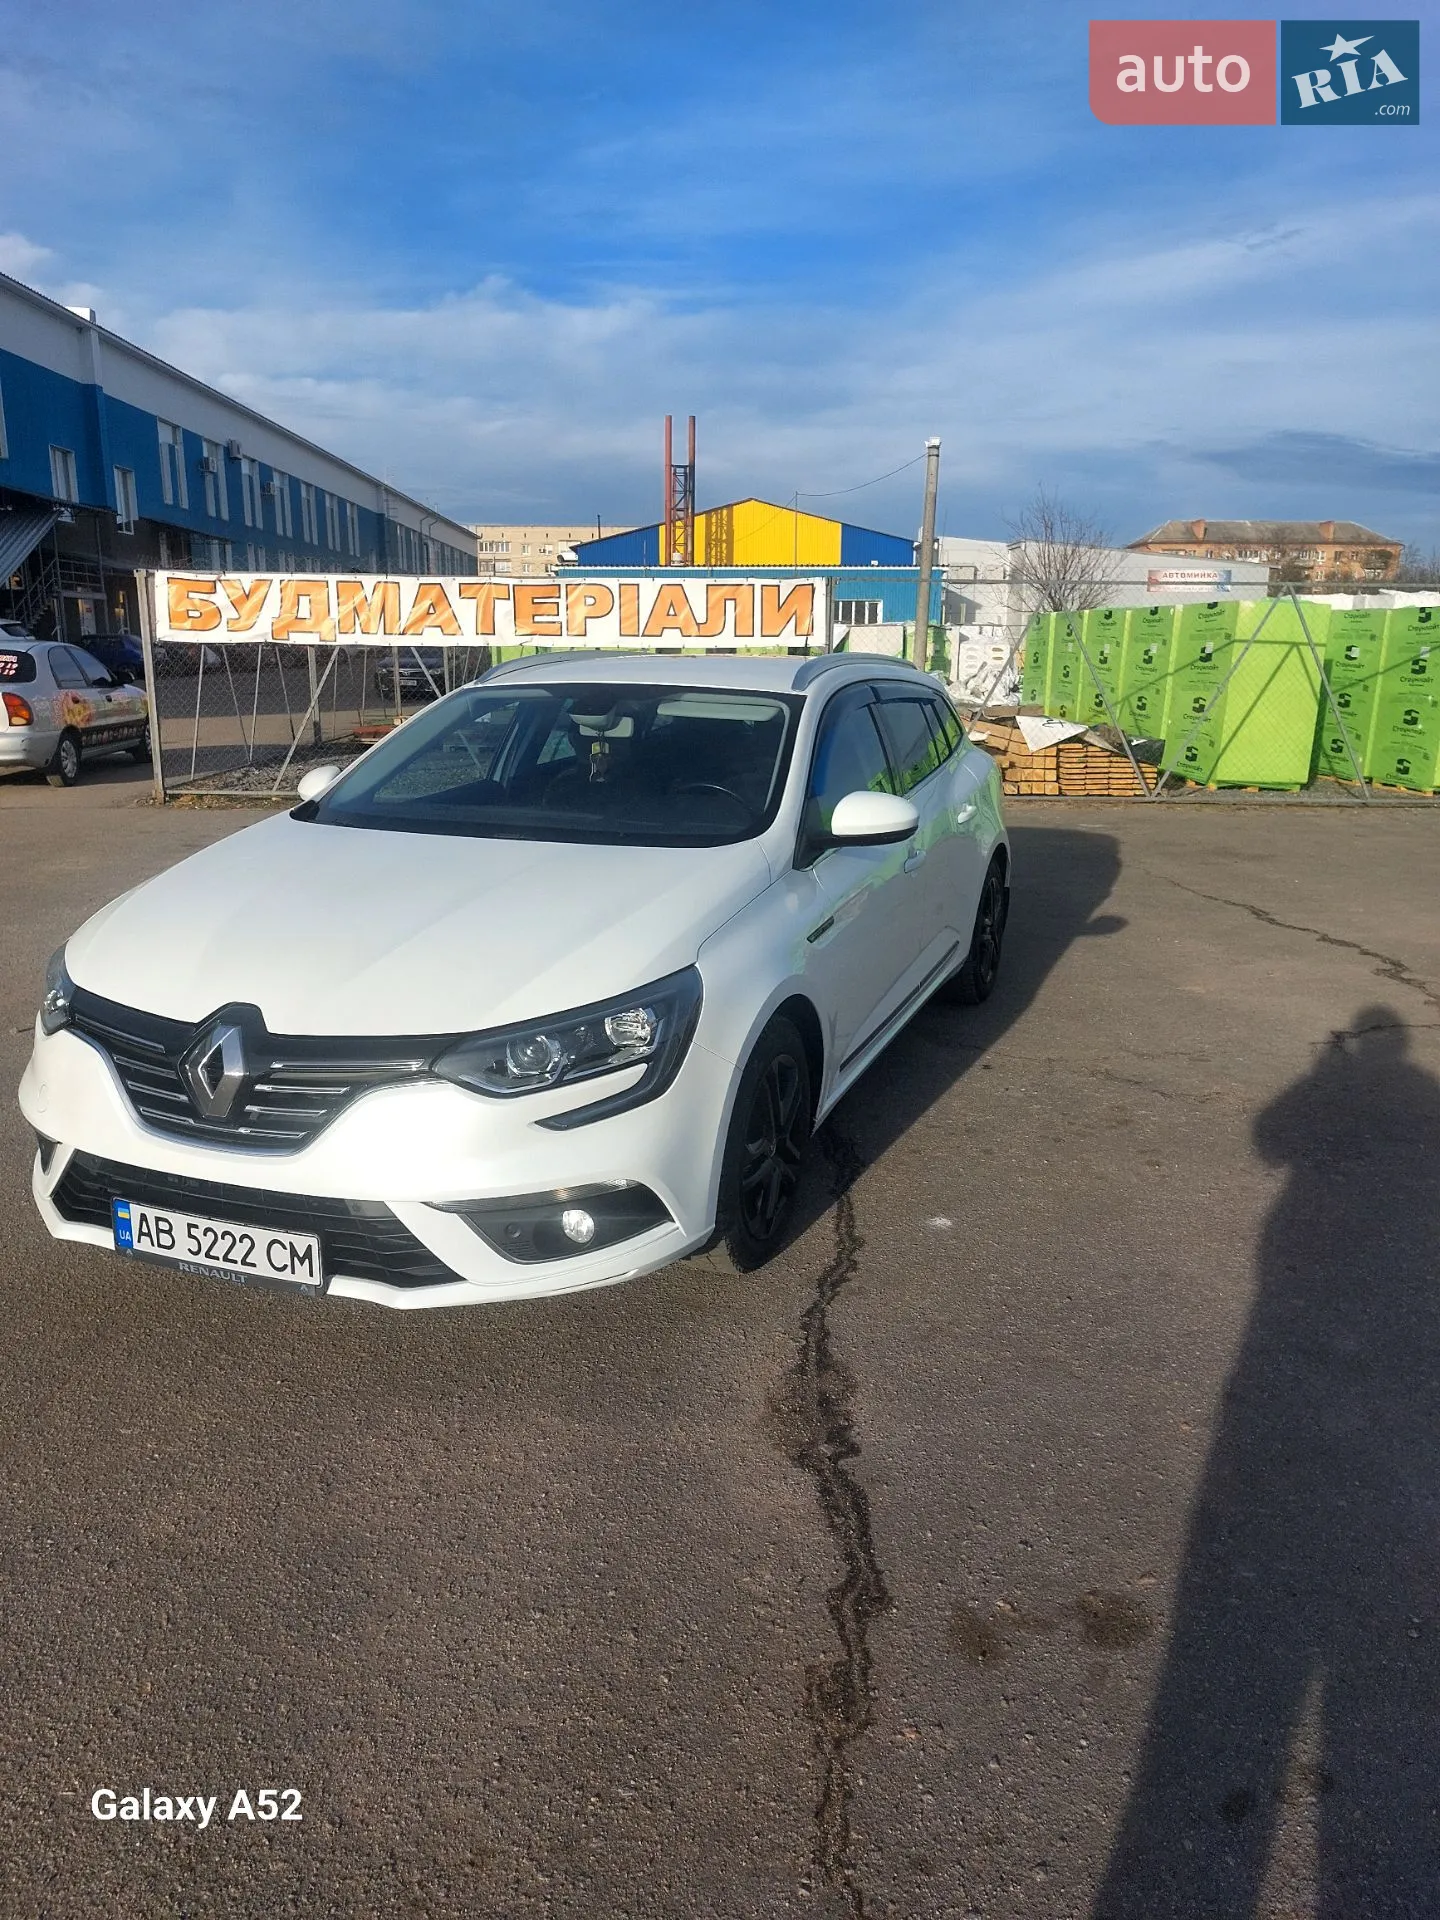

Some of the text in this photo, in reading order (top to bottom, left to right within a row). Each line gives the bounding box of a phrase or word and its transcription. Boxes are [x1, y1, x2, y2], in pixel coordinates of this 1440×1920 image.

[166, 576, 816, 643] БУДМАТЕРІАЛИ
[119, 1229, 132, 1242] UA
[137, 1213, 315, 1278] AB 5222 CM
[178, 1262, 249, 1284] RENAULT
